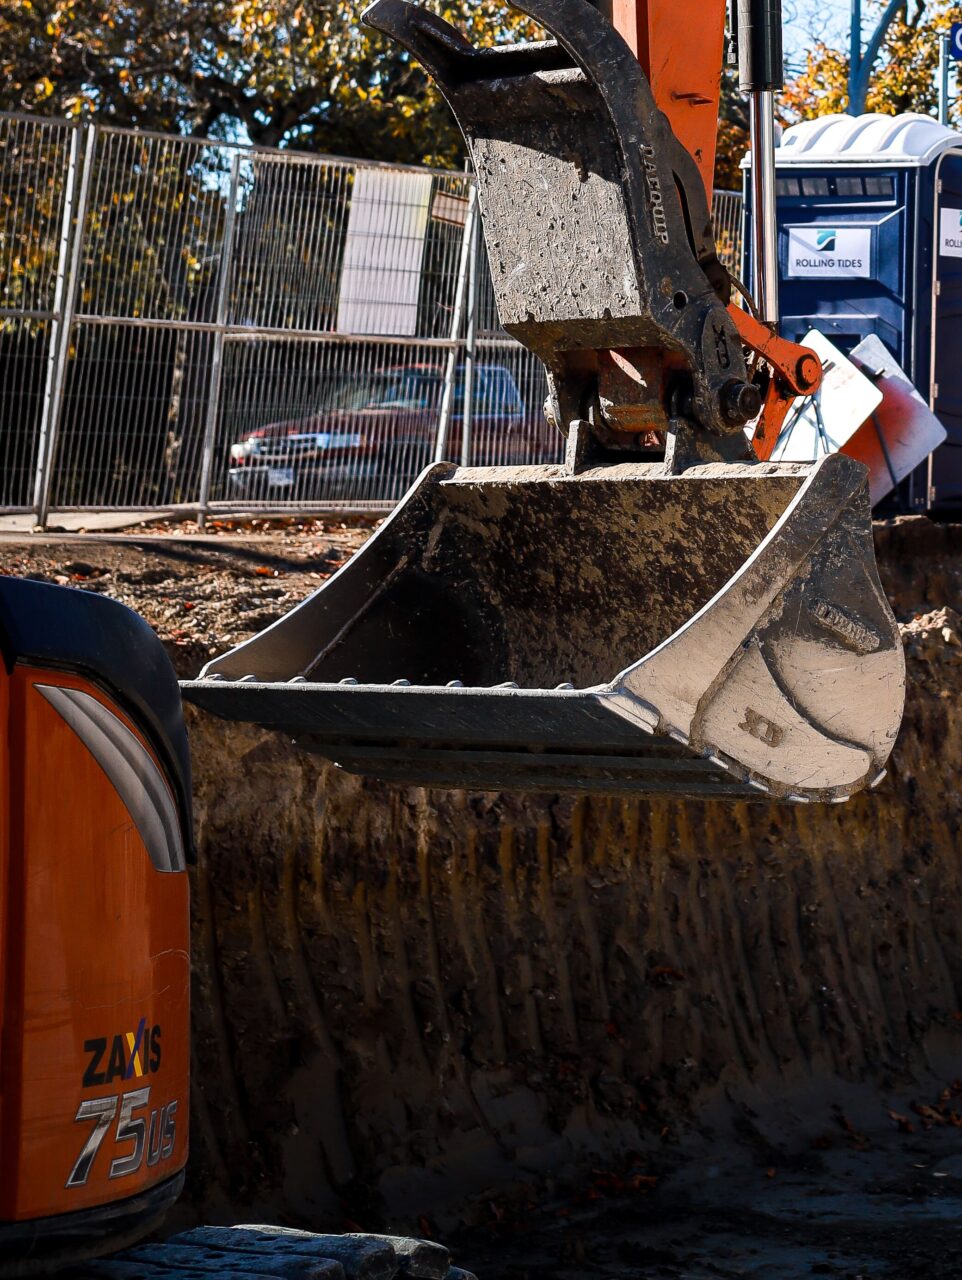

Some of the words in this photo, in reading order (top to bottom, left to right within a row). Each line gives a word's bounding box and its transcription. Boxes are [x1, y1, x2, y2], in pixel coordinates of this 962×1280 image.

[795, 258, 836, 268] ROLLING
[837, 258, 863, 268] TIDES
[82, 1017, 161, 1088] ZAXIS
[64, 1086, 178, 1188] 75US
